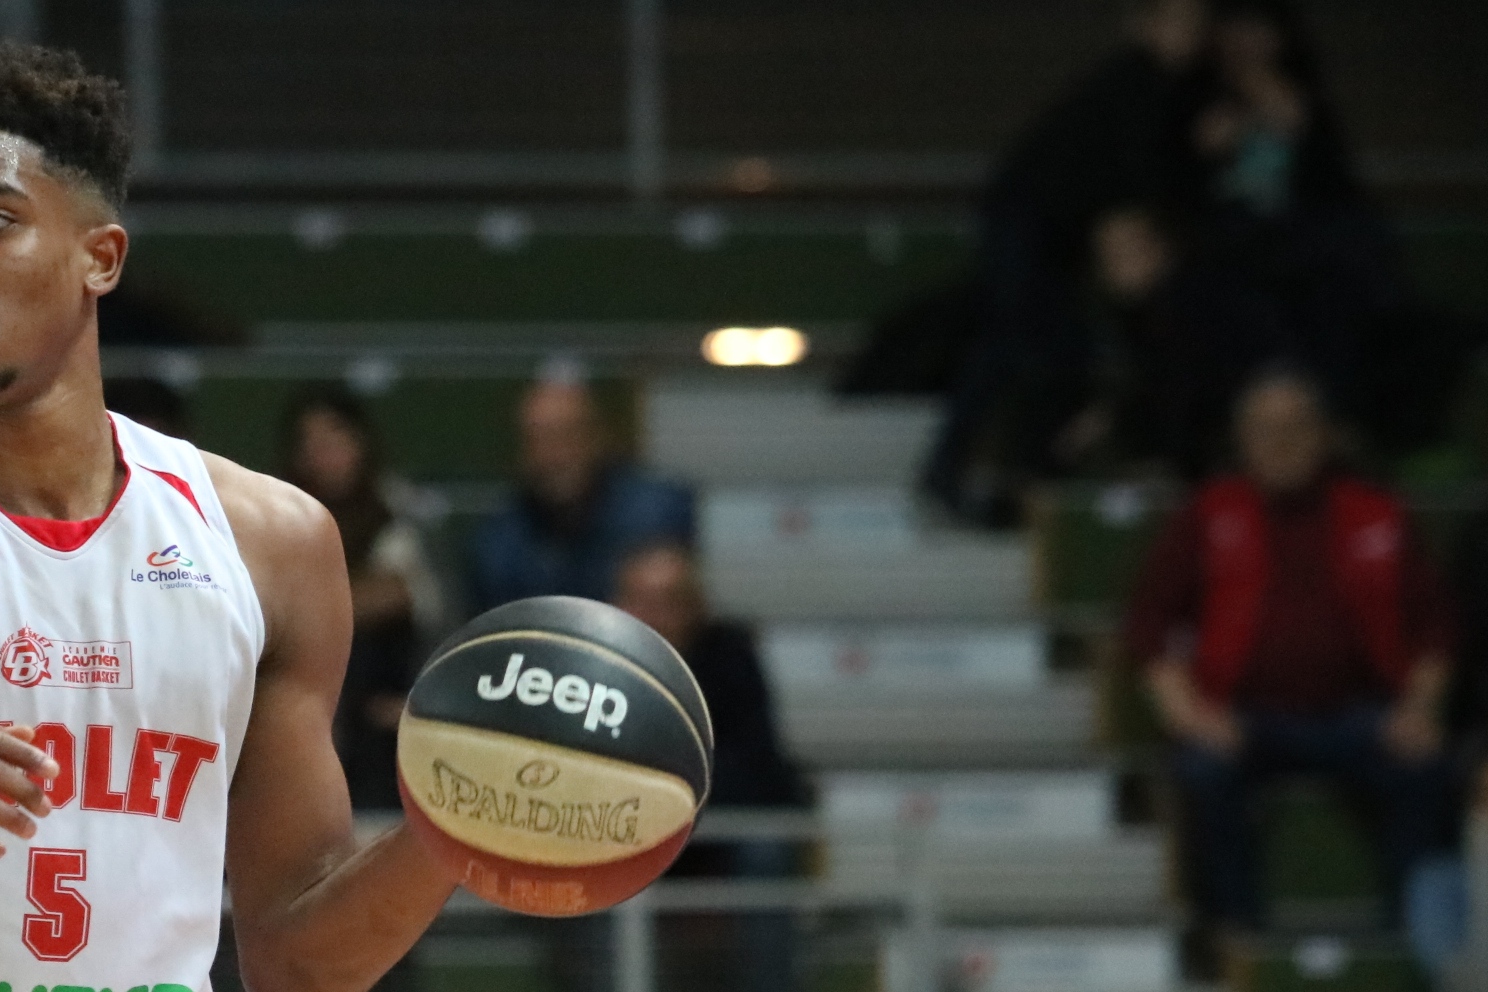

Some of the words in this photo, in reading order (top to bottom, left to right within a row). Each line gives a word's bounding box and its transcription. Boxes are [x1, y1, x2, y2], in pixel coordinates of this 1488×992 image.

[131, 568, 144, 582] Le
[63, 670, 89, 684] CHOLET
[91, 671, 120, 684] BASKET
[477, 653, 628, 732] Jeep
[427, 757, 642, 845] SPALDING
[22, 847, 92, 963] 5
